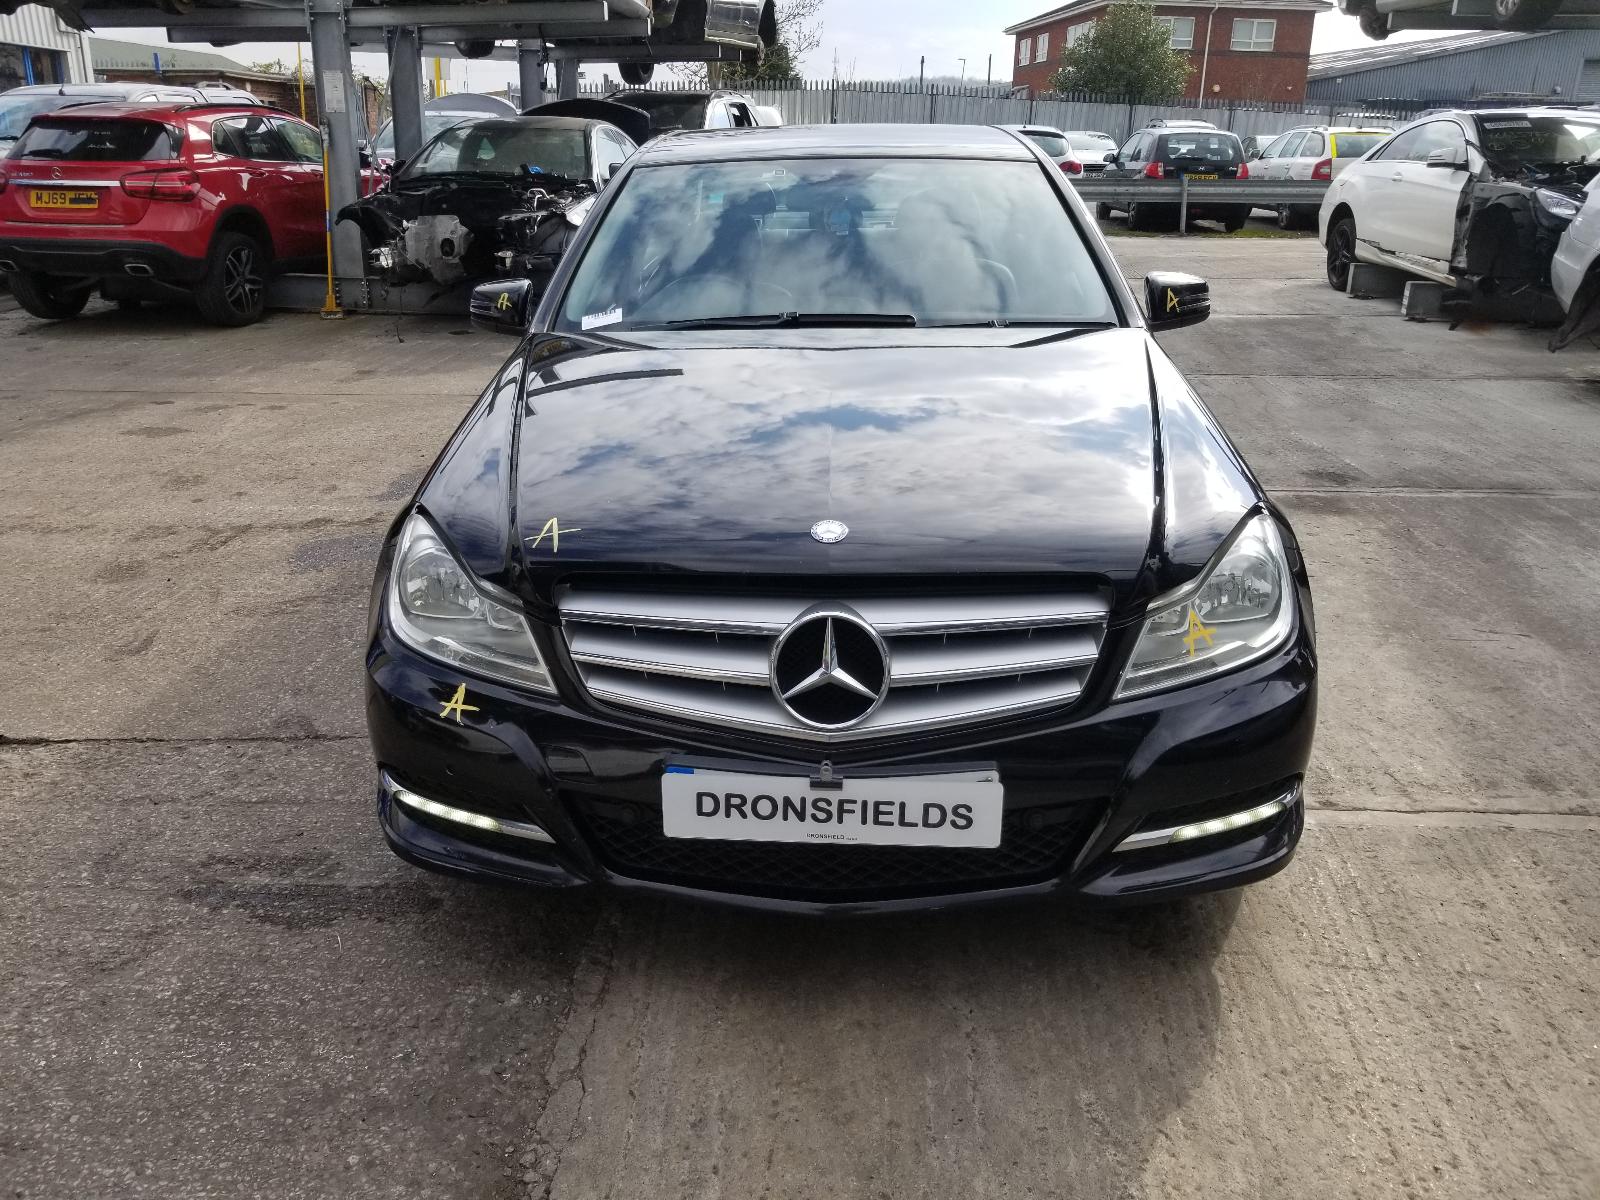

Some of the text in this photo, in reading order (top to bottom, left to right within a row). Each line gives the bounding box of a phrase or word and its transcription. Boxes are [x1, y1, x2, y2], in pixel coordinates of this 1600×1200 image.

[35, 191, 67, 205] MJ69
[523, 517, 582, 553] A
[1183, 607, 1217, 657] A
[439, 682, 481, 726] A
[695, 791, 974, 831] DRONSFIELDS
